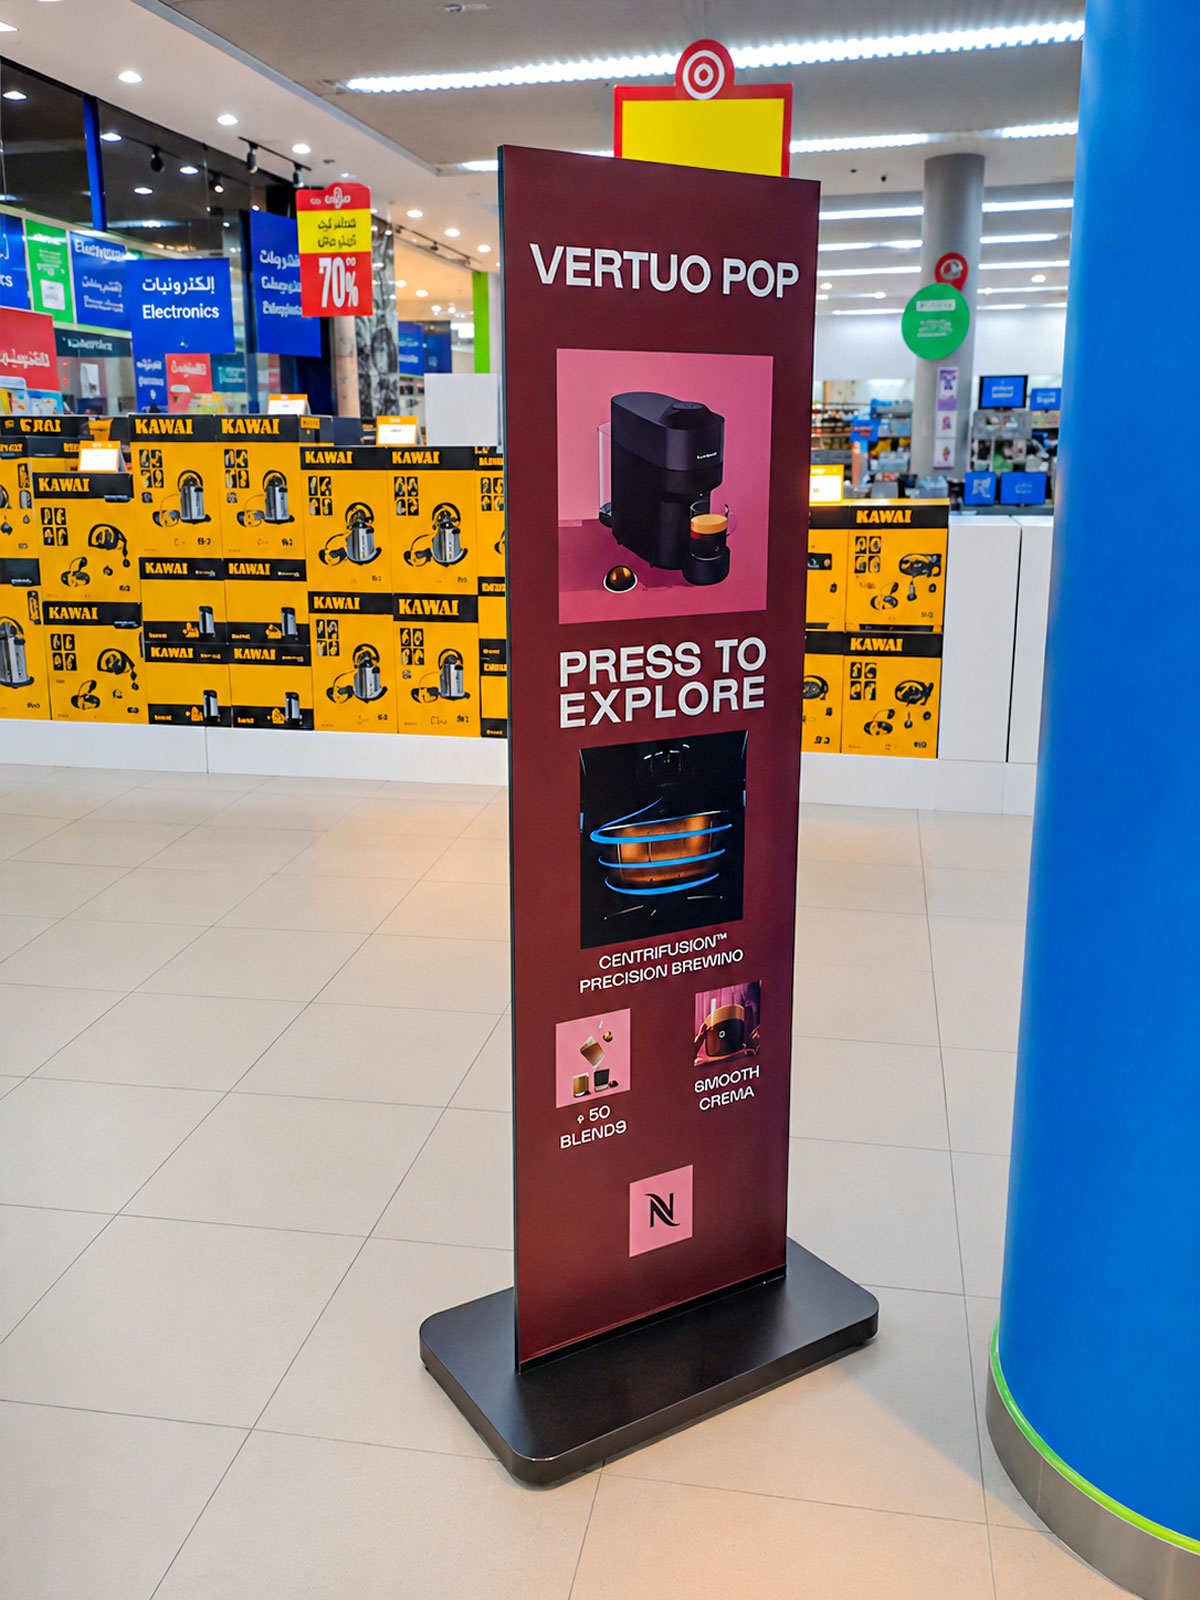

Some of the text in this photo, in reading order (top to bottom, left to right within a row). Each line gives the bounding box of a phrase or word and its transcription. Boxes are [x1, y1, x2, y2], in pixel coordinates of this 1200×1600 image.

[529, 243, 799, 298] VERTUO POP
[142, 303, 219, 319] Electronics
[134, 418, 193, 434] KAWAI
[221, 418, 280, 434] KAWAI
[304, 450, 353, 464] KAWAI
[391, 451, 440, 465] KAWAI
[38, 477, 90, 492] KAWAI
[855, 509, 912, 524] KAWAI
[145, 562, 188, 575] KAWAI
[228, 563, 271, 576] KAWAI
[313, 596, 361, 610] KAWAI
[398, 598, 460, 616] KAWAI
[48, 606, 98, 620] KAWAI
[850, 637, 904, 652] KAWAI
[150, 646, 194, 659] KAWAI
[233, 647, 276, 661] KAWAI
[559, 636, 767, 688] PRESS TO
[560, 675, 766, 729] EXPLORE
[579, 964, 669, 993] PRECISION
[694, 1065, 760, 1094] SMOOTH
[698, 1086, 755, 1111] CREMA
[589, 1105, 611, 1122] 50
